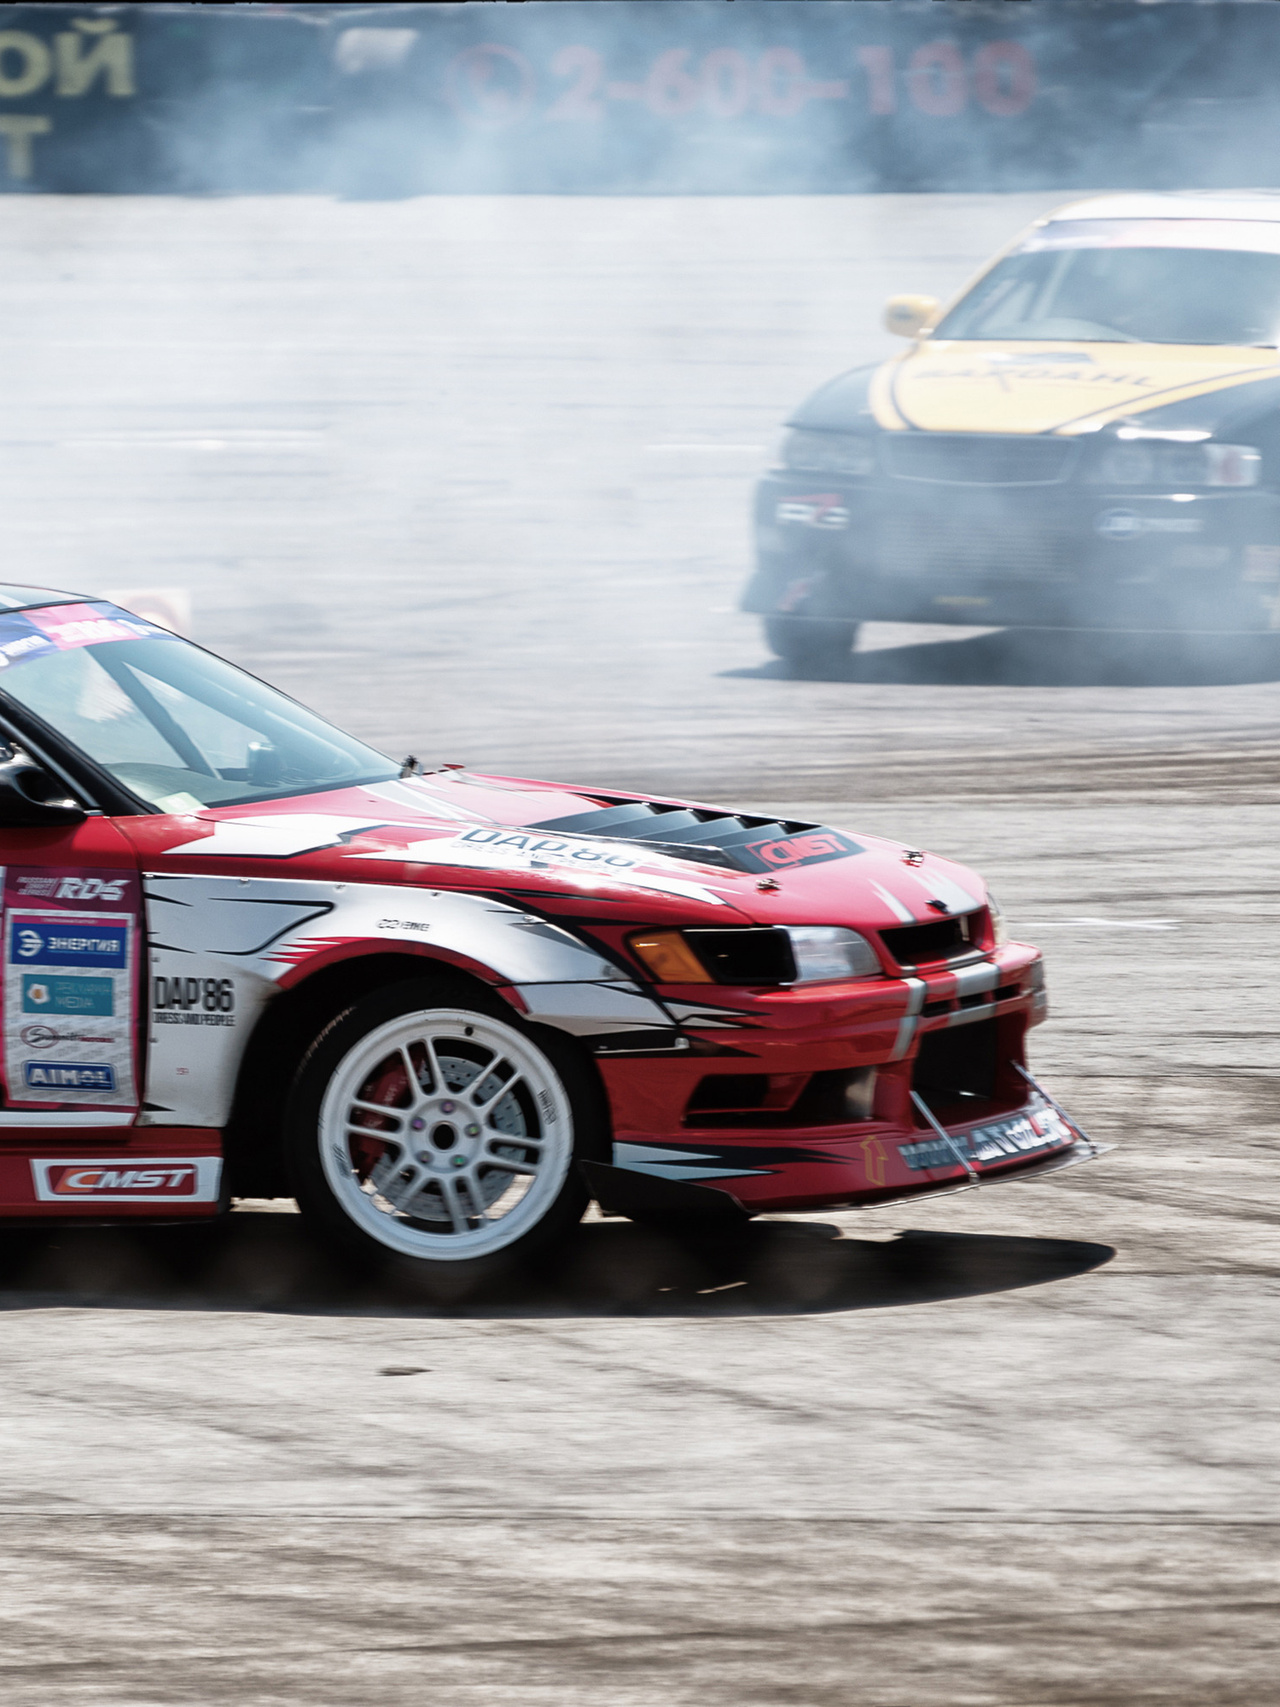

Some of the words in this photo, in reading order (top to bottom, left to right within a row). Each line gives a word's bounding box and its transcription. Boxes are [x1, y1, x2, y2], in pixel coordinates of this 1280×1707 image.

[546, 40, 1040, 122] 2-600-100
[46, 936, 120, 953] ЭНЕРГИЯ
[62, 1168, 196, 1189] CMST
